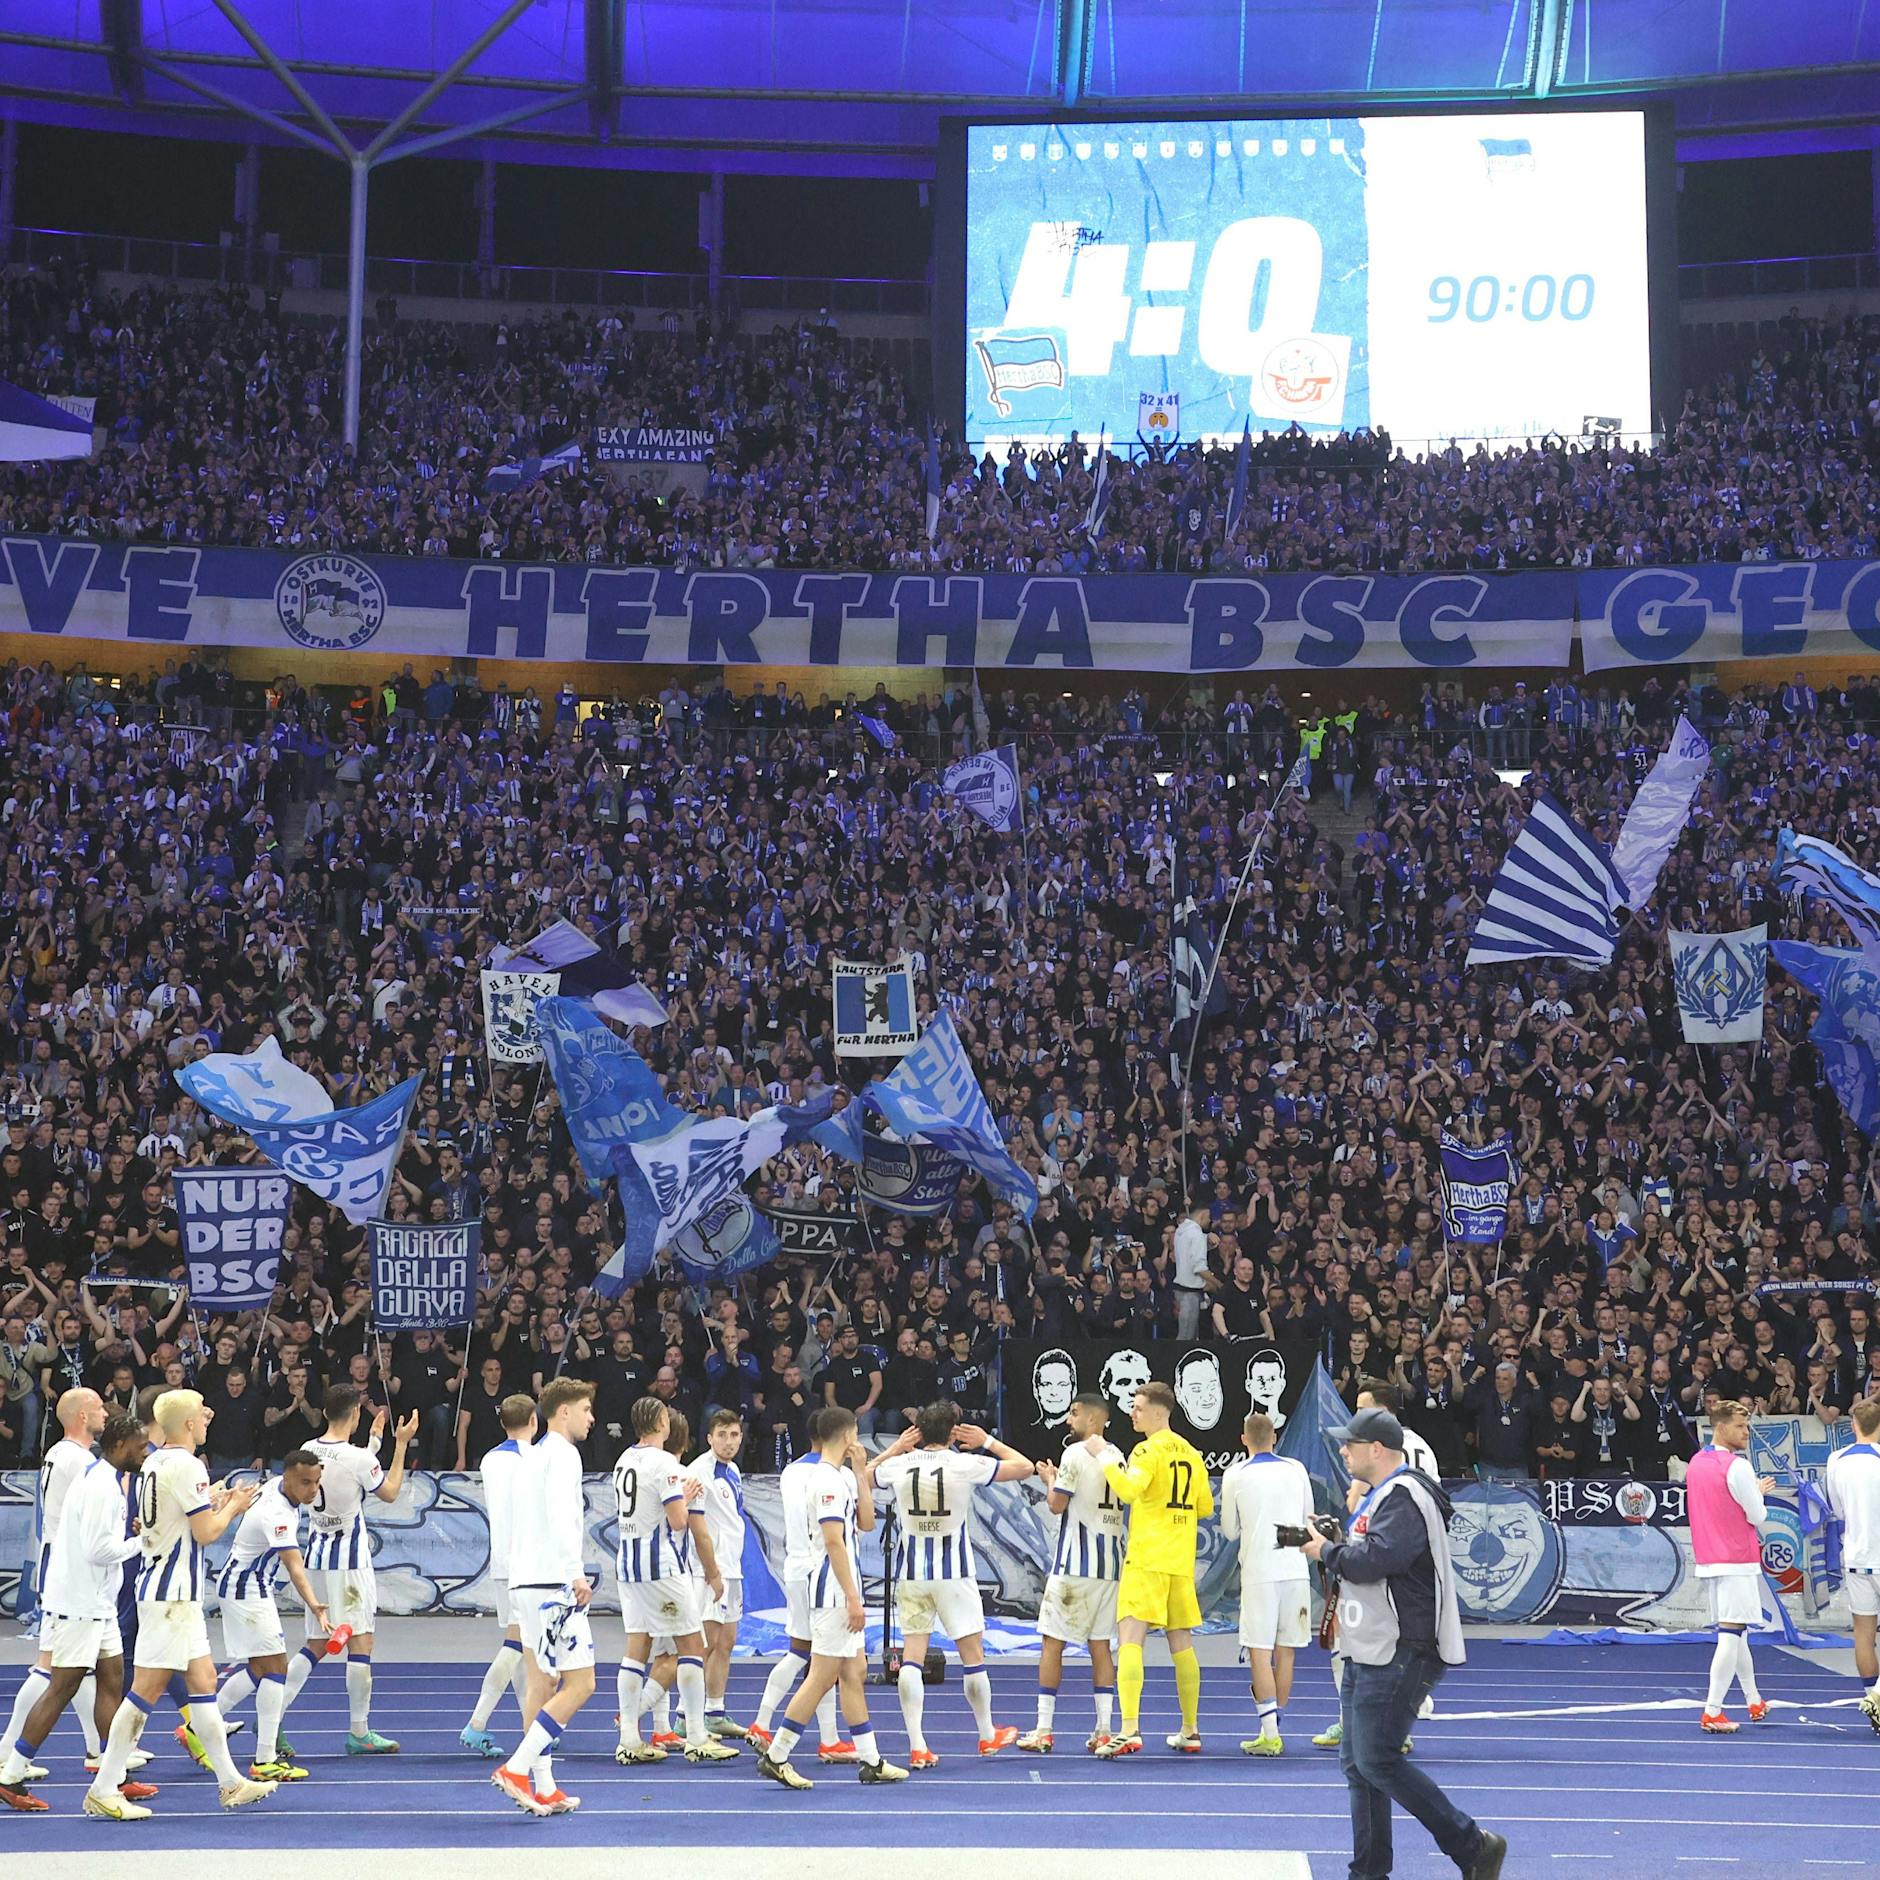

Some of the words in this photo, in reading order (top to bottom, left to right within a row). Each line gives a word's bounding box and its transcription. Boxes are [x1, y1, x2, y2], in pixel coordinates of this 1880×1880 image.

[1427, 273, 1596, 323] 90:00
[1140, 393, 1155, 406] 32
[597, 427, 631, 445] EXY
[286, 558, 377, 593] OSTKURVE
[362, 598, 379, 609] 92
[461, 566, 1095, 667] HERTHA
[1185, 575, 1489, 669] BSC
[283, 609, 346, 648] HERTHA
[348, 613, 378, 645] BSC
[489, 974, 552, 996] HAVEL
[491, 1036, 545, 1060] KOLONN
[864, 1033, 915, 1046] HERTHA
[182, 1177, 290, 1214] NUR
[186, 1217, 285, 1254] DER
[375, 1227, 469, 1259] RAGAZZI
[188, 1257, 280, 1295] BSC
[377, 1258, 467, 1289] DELLA
[1781, 1281, 1801, 1289] NICHT
[378, 1289, 466, 1317] CURVA
[906, 1466, 951, 1517] 11
[918, 1521, 940, 1532] REESE
